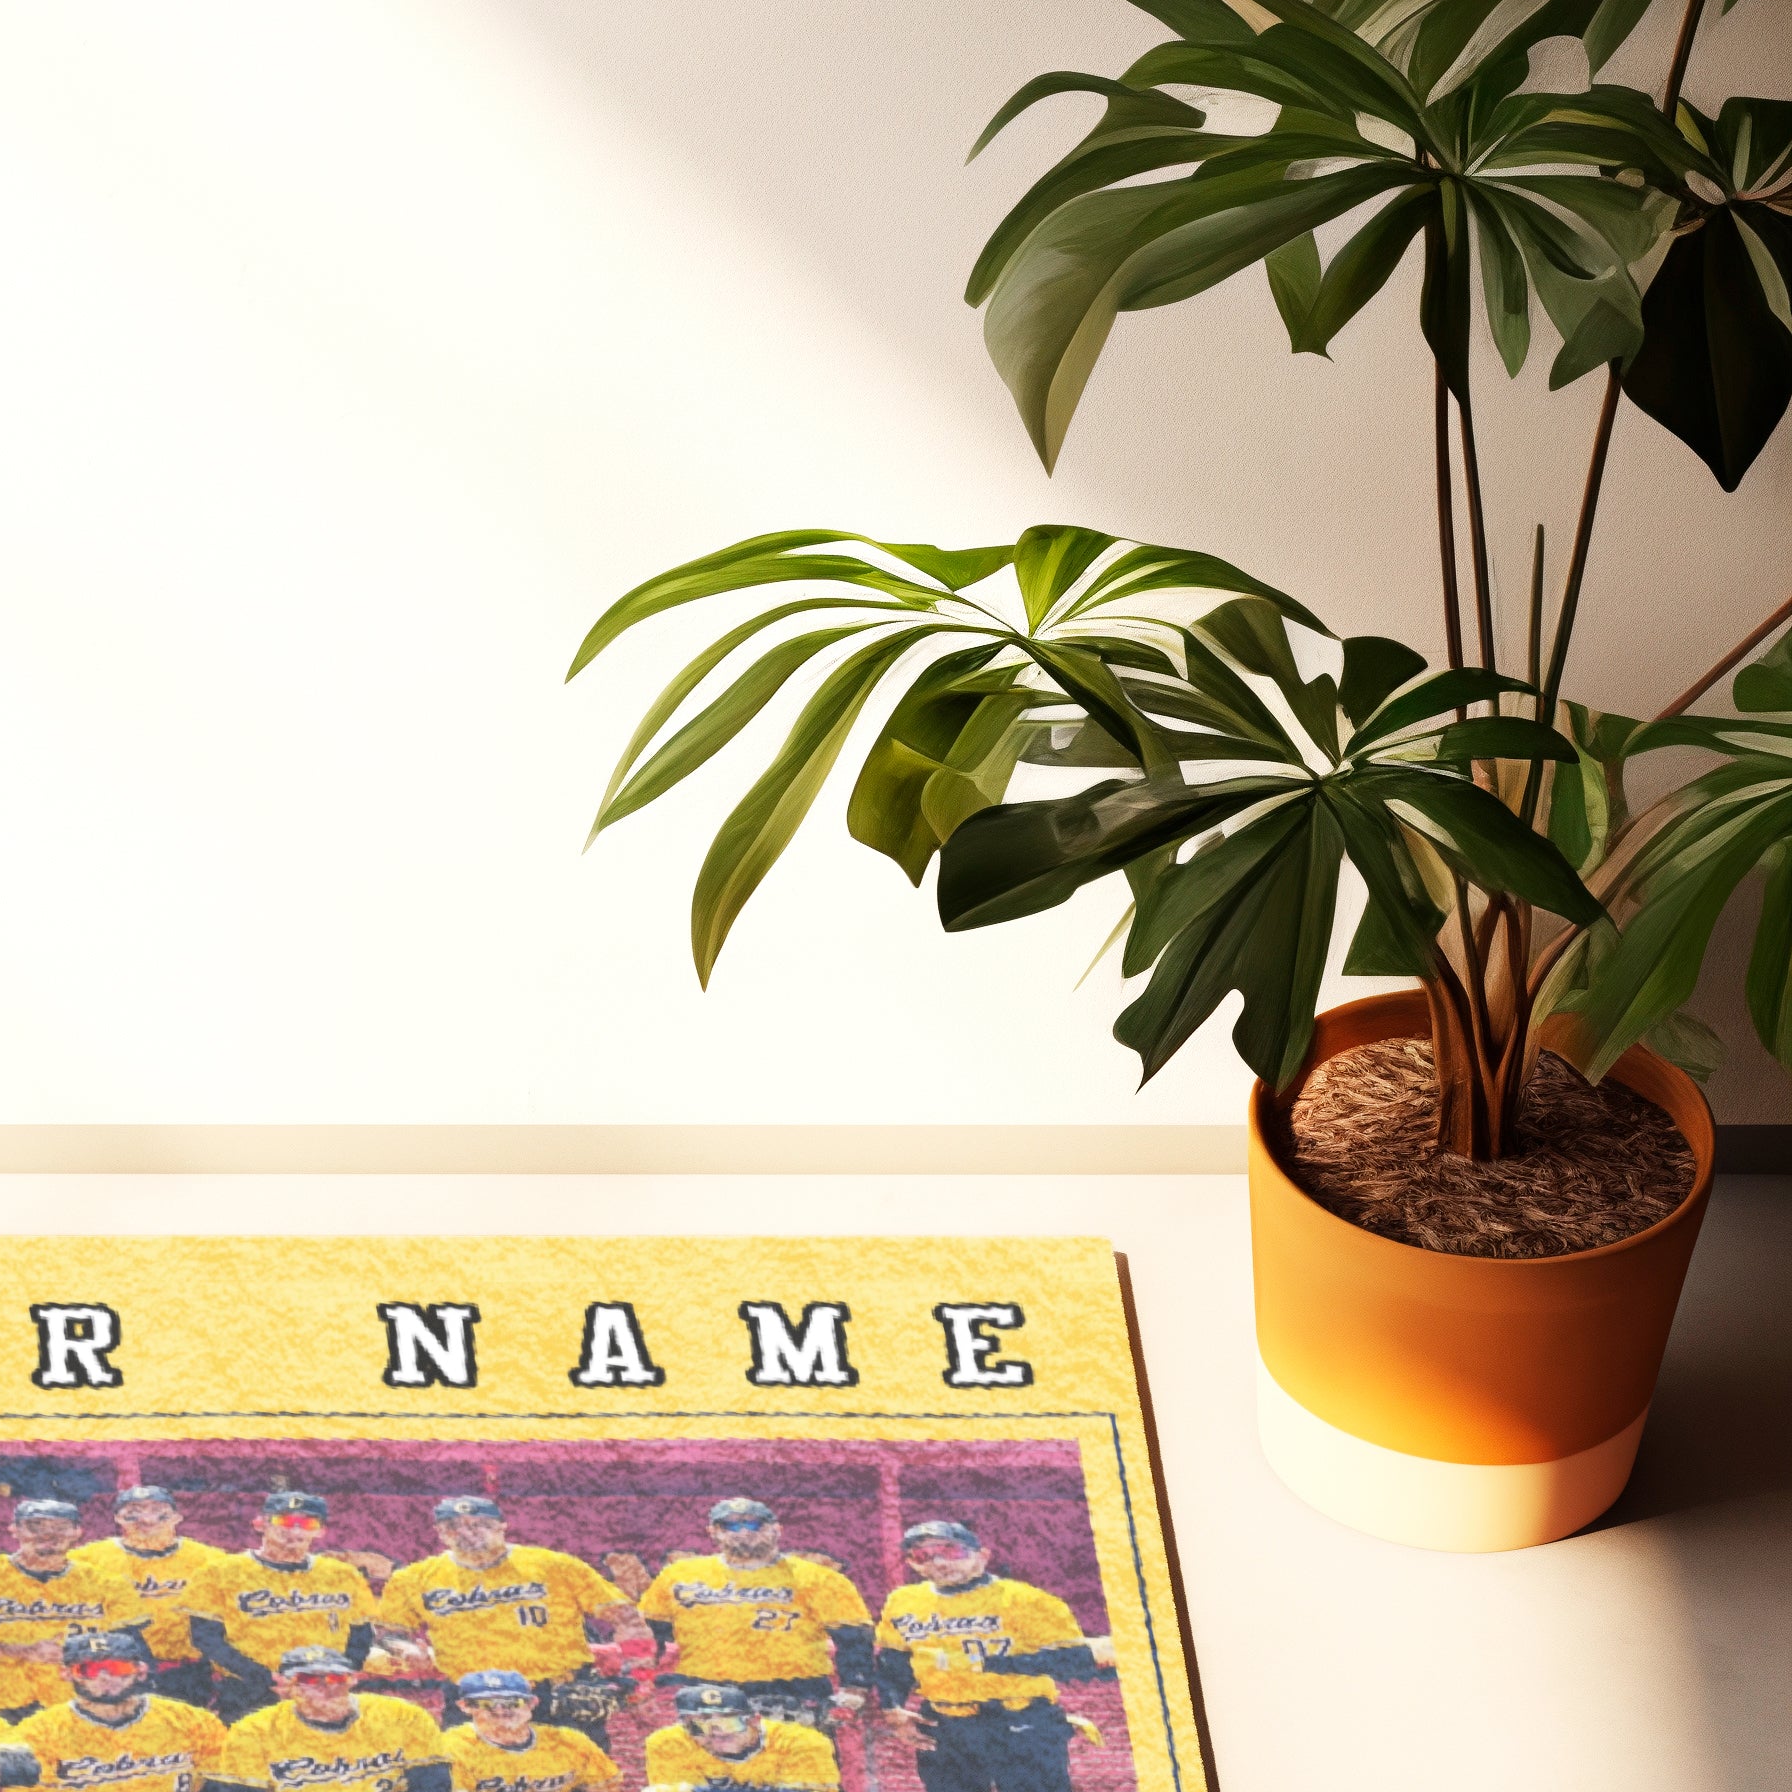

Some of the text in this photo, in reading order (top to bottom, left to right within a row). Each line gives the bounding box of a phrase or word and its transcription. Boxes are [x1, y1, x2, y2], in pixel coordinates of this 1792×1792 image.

[377, 1301, 1034, 1389] NAME
[514, 1604, 549, 1628] 10
[751, 1608, 802, 1632] 27
